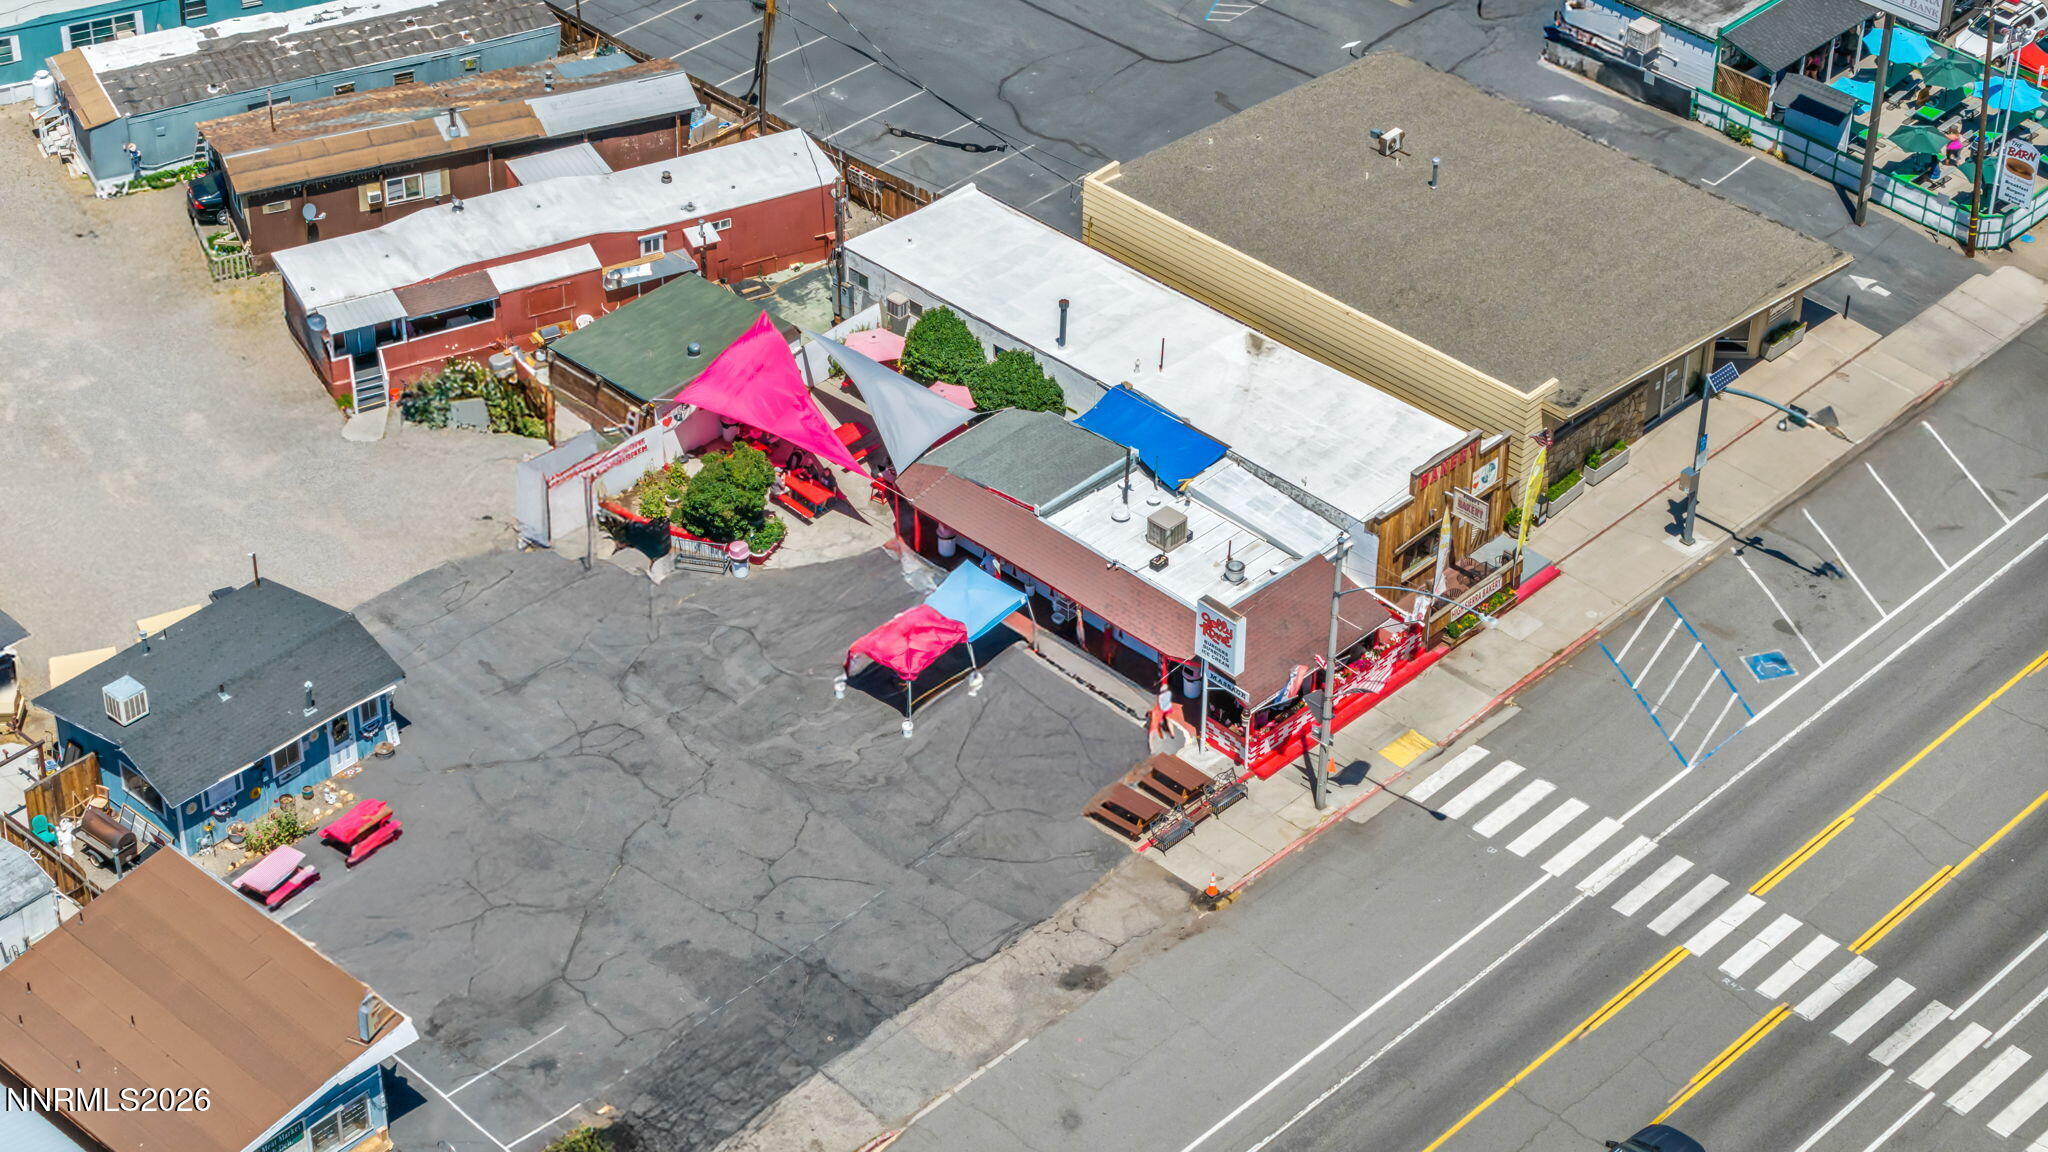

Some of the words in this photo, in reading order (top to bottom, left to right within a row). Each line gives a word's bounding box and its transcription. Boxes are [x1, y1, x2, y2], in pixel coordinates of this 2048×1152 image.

[1909, 0, 1939, 17] BANK
[2011, 140, 2023, 149] THE
[2008, 147, 2037, 161] BARN
[1202, 644, 1230, 663] BURRITOS
[1203, 639, 1229, 657] BURGERS
[1201, 649, 1211, 658] ICE
[1211, 654, 1230, 669] CREAM
[1210, 673, 1247, 699] MASSAGE
